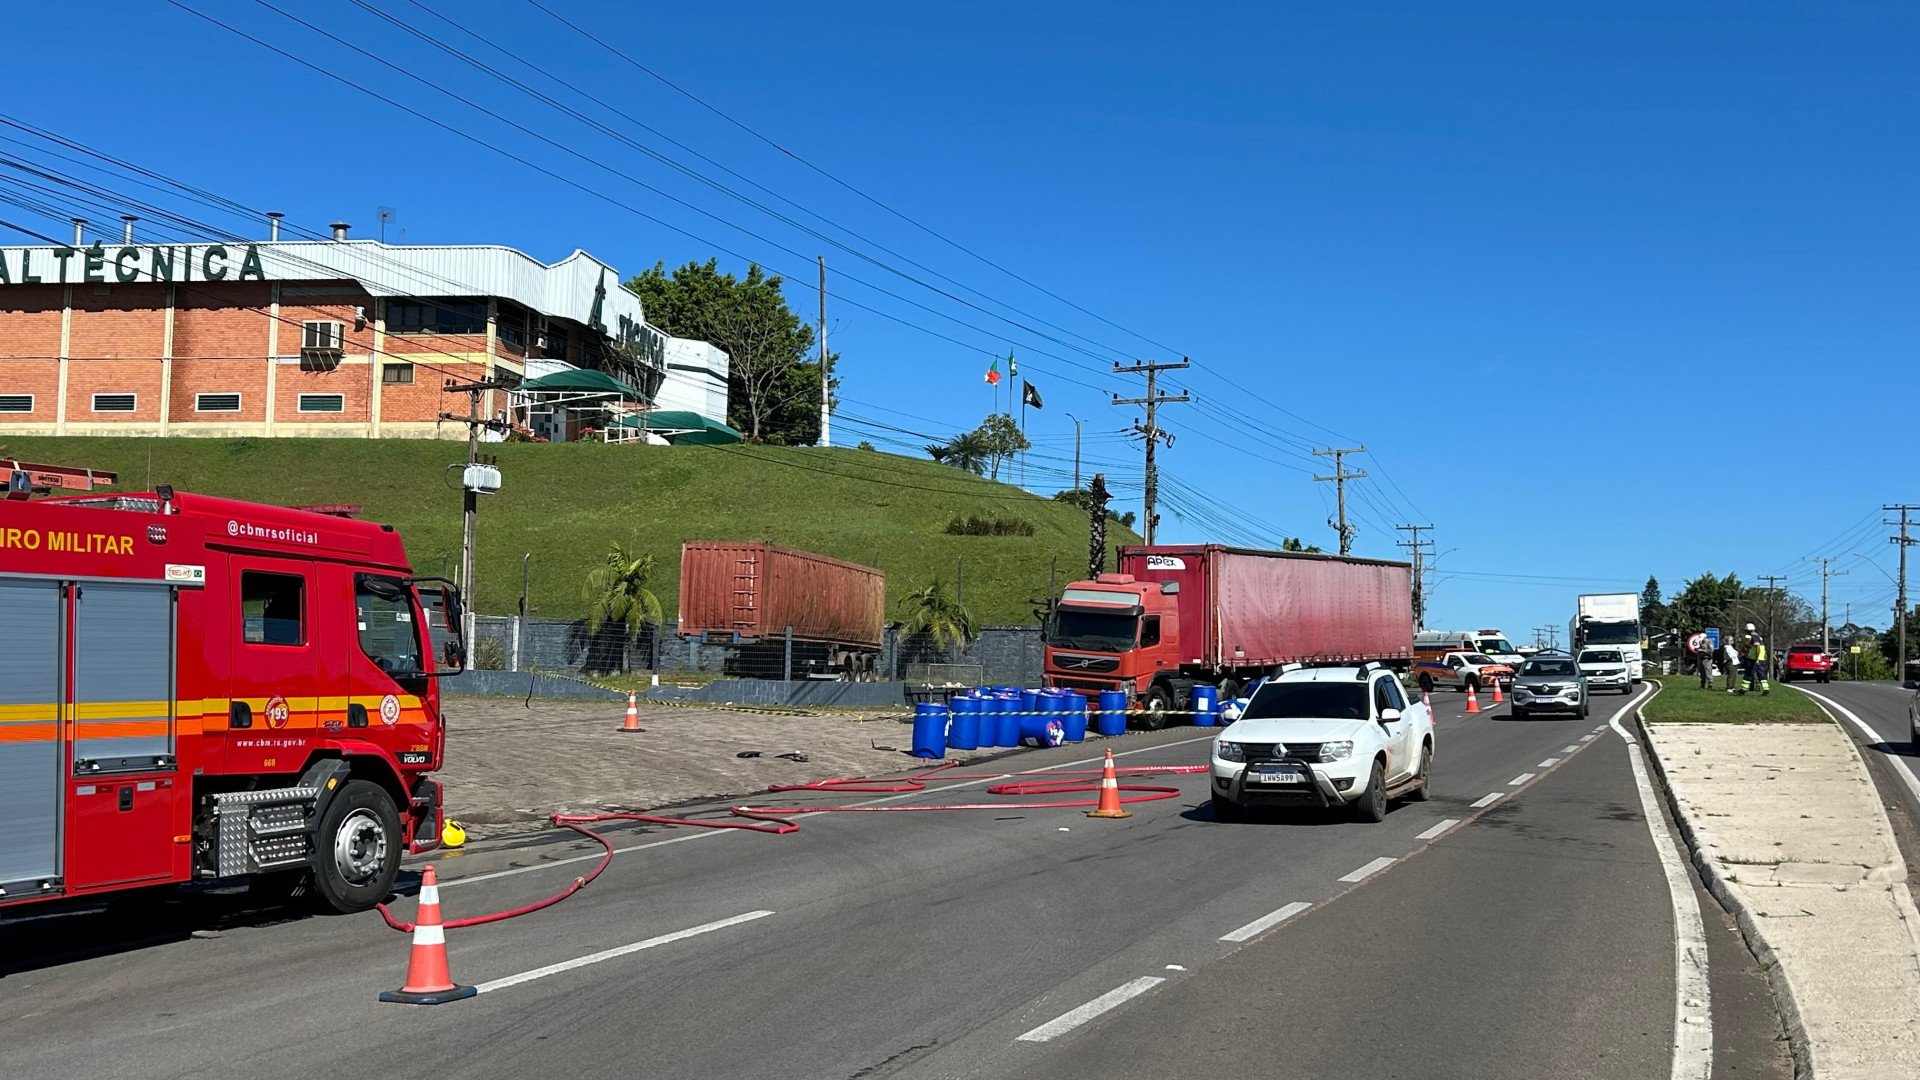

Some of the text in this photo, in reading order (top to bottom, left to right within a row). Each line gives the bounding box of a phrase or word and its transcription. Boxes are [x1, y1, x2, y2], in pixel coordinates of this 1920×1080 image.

[227, 519, 318, 544] @cbmrsoficial
[48, 530, 135, 556] MILITAR
[268, 707, 288, 720] 193
[236, 738, 306, 748] www.cbm.rs.gov.br
[403, 756, 426, 764] VOLVO
